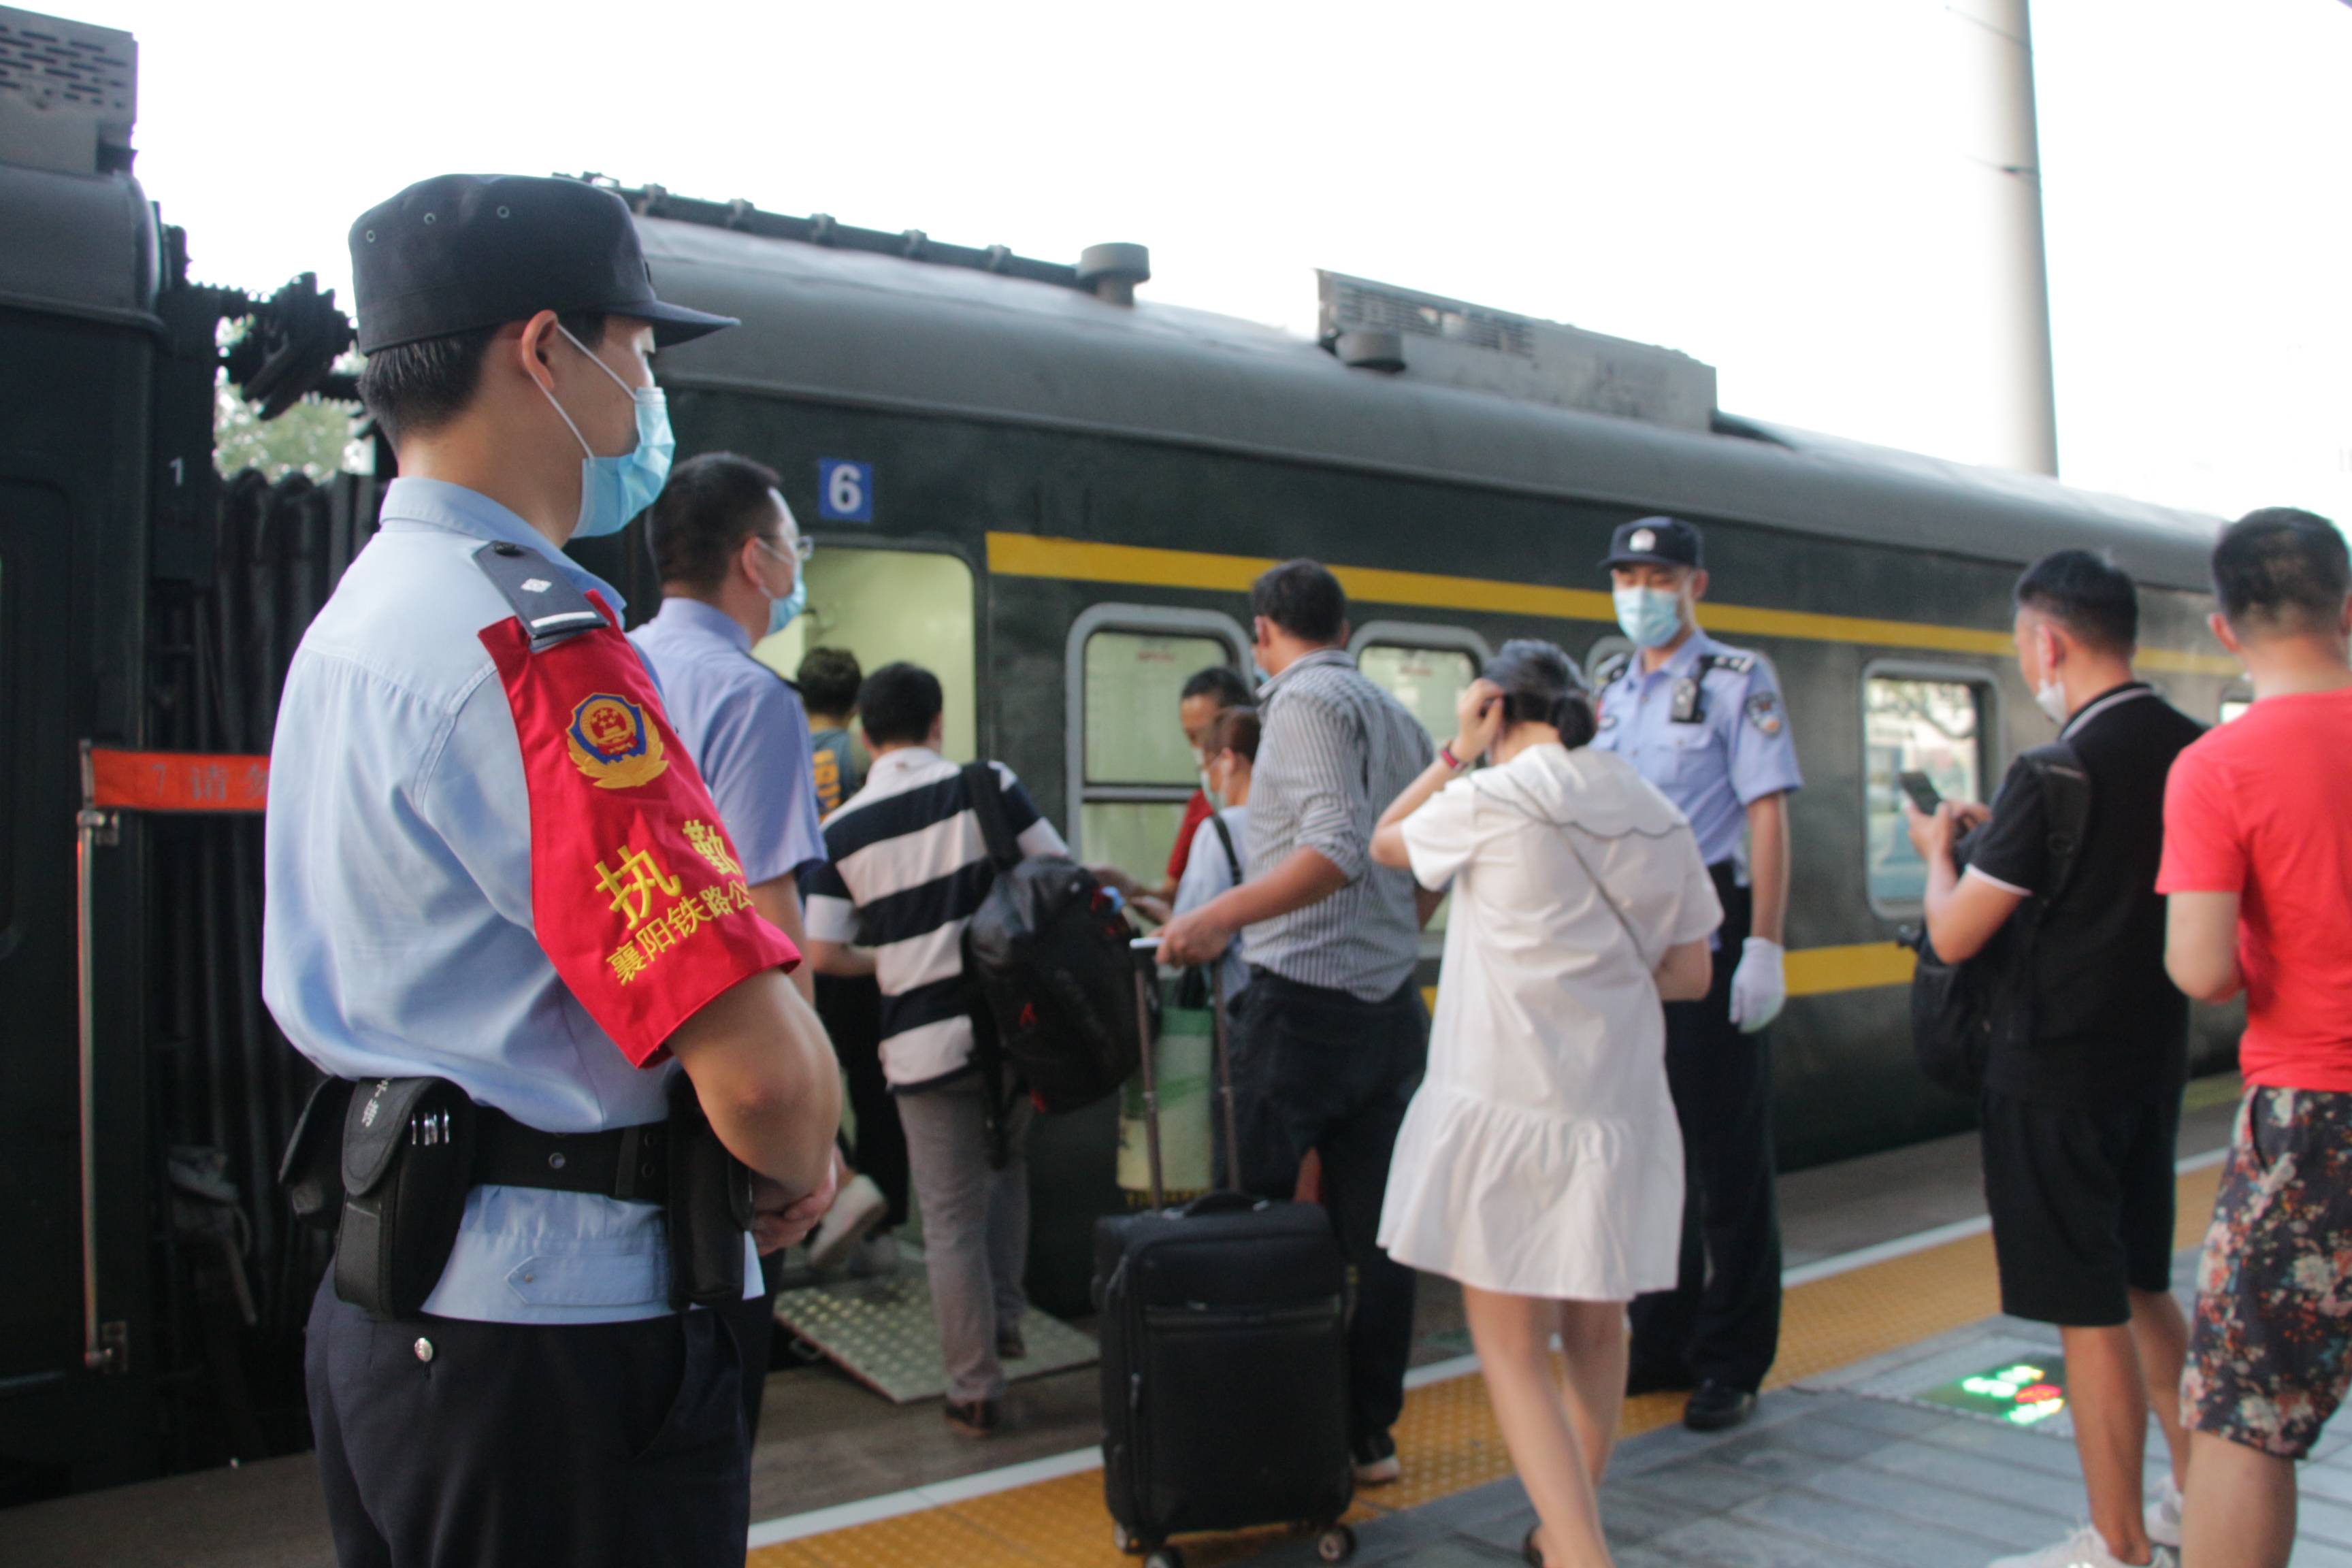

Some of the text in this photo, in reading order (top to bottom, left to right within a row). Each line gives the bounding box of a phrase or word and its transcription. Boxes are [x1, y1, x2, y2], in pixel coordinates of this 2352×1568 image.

[169, 457, 184, 486] 1
[830, 464, 862, 513] 6
[594, 819, 742, 930] 执勤
